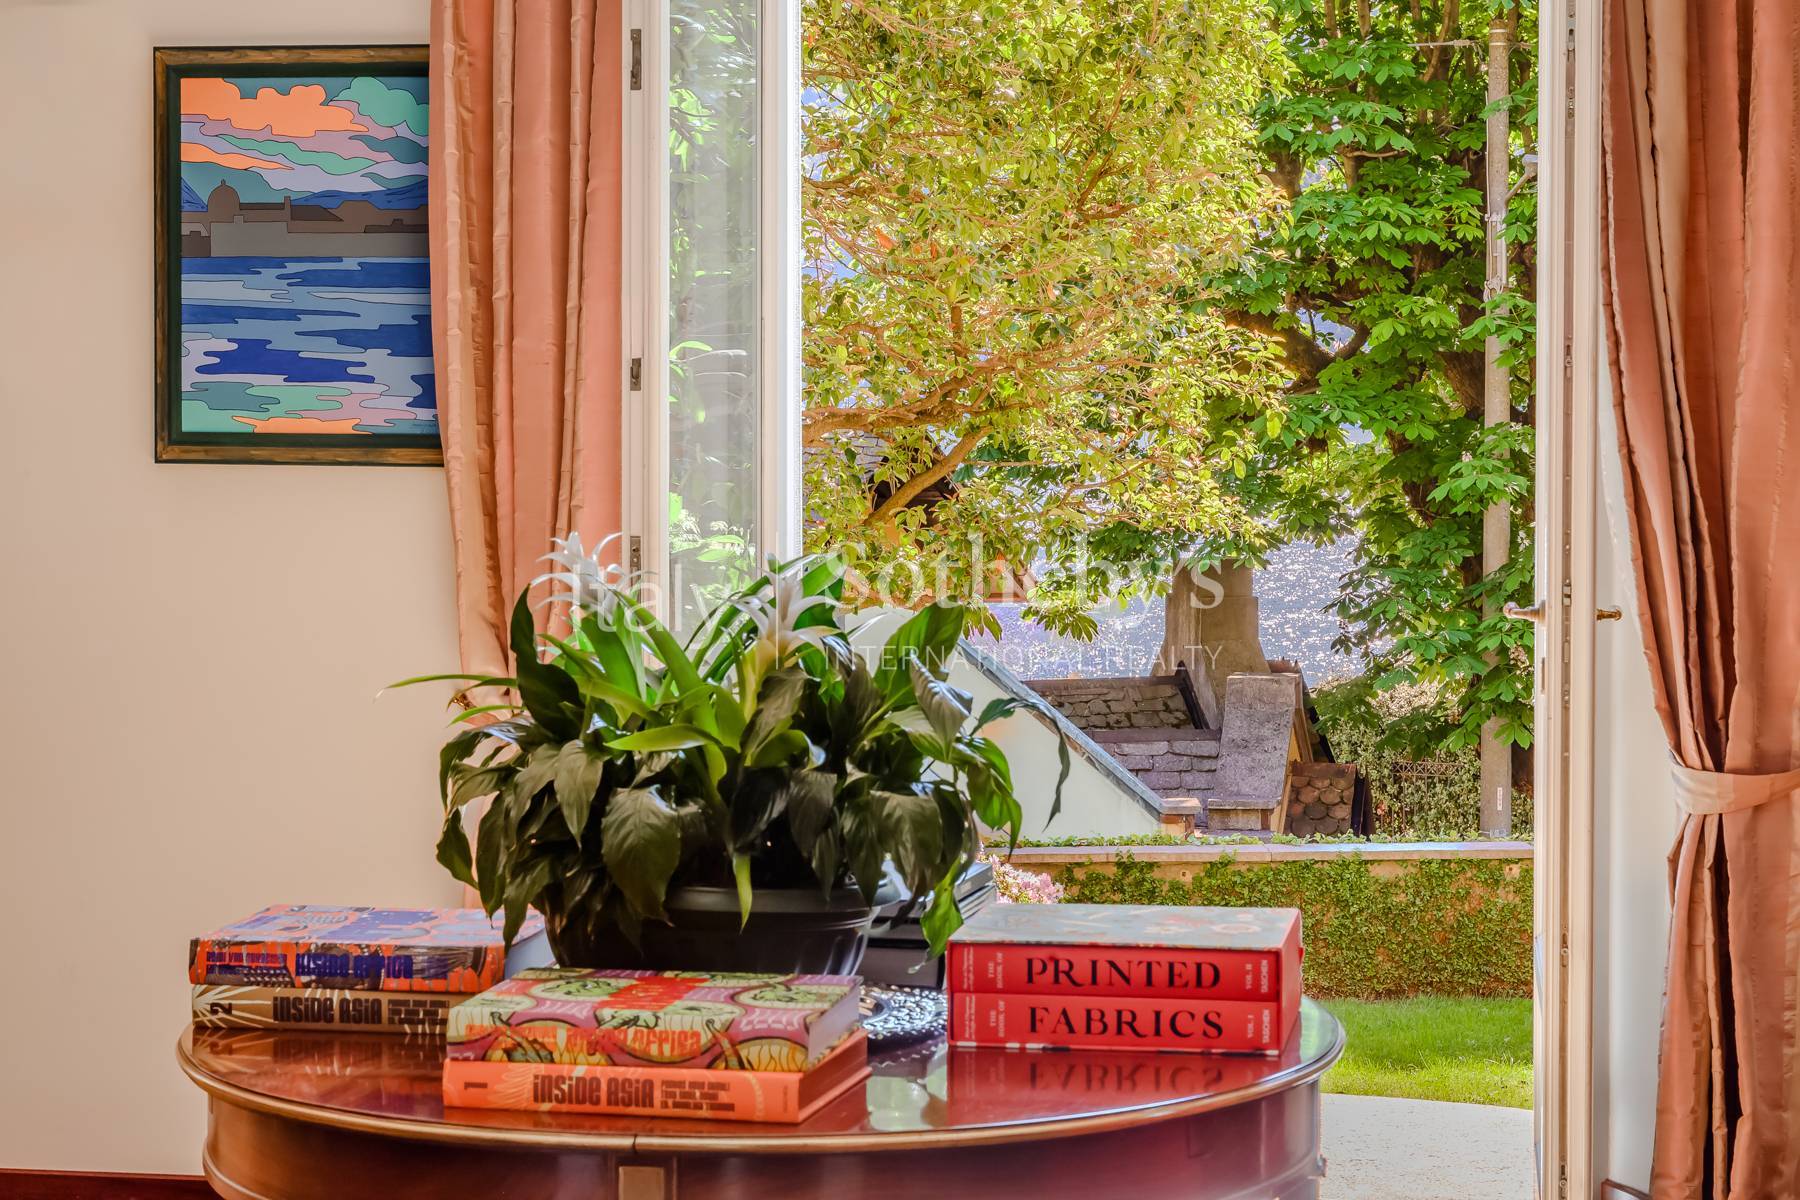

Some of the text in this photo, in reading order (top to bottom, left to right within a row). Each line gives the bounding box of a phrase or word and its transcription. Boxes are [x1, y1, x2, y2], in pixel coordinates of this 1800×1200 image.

[1025, 957, 1222, 991] PRINTED
[1260, 958, 1269, 994] TASCHEN
[1028, 1006, 1224, 1039] FABRICS
[1262, 1008, 1271, 1044] TASCHEN
